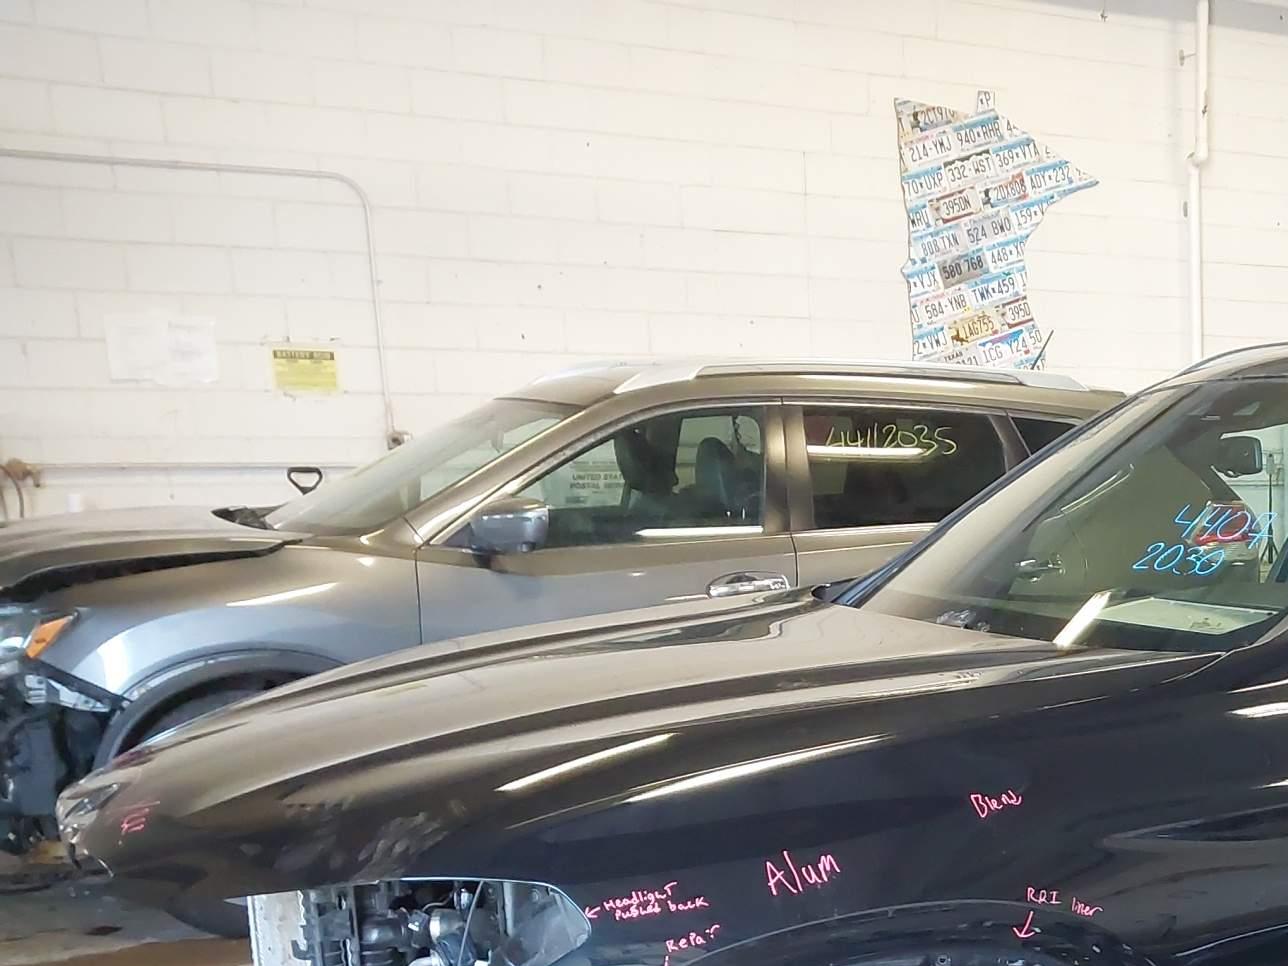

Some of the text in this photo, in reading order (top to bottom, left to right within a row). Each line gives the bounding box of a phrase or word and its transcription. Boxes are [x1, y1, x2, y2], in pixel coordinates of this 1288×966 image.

[1174, 503, 1278, 550] 4407
[1131, 542, 1225, 576] 2030
[766, 850, 841, 896] Alum
[667, 896, 710, 913] back
